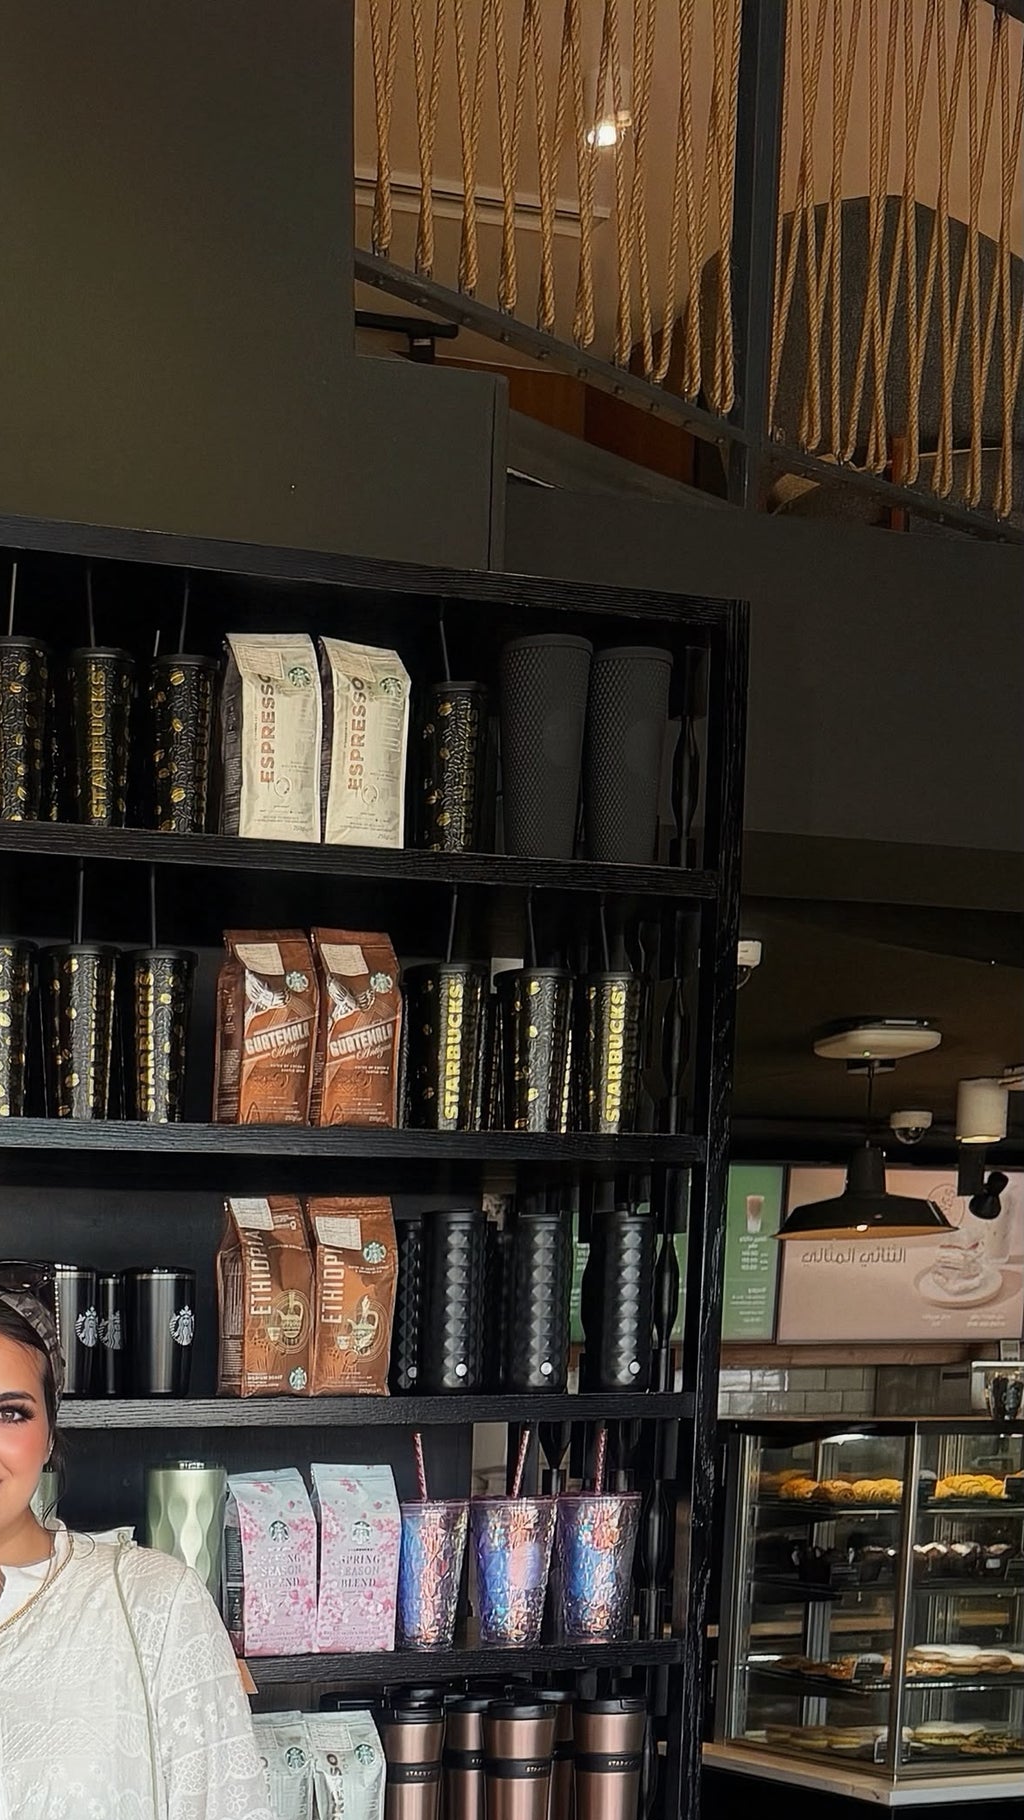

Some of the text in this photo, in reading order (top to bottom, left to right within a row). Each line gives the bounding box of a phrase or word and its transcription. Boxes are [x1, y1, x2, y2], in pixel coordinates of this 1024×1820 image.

[91, 668, 108, 818] STARBUCKS
[347, 676, 367, 790] ESPRESSO
[245, 1021, 311, 1056] GUATEMALA
[329, 1023, 394, 1058] GUATEMALA
[444, 982, 464, 1120] STARBUCKS
[605, 988, 626, 1122] STARBUCKS
[244, 1230, 272, 1315] ETHIOPIA
[321, 1248, 345, 1324] ETHIOPI
[341, 1566, 380, 1576] EASON
